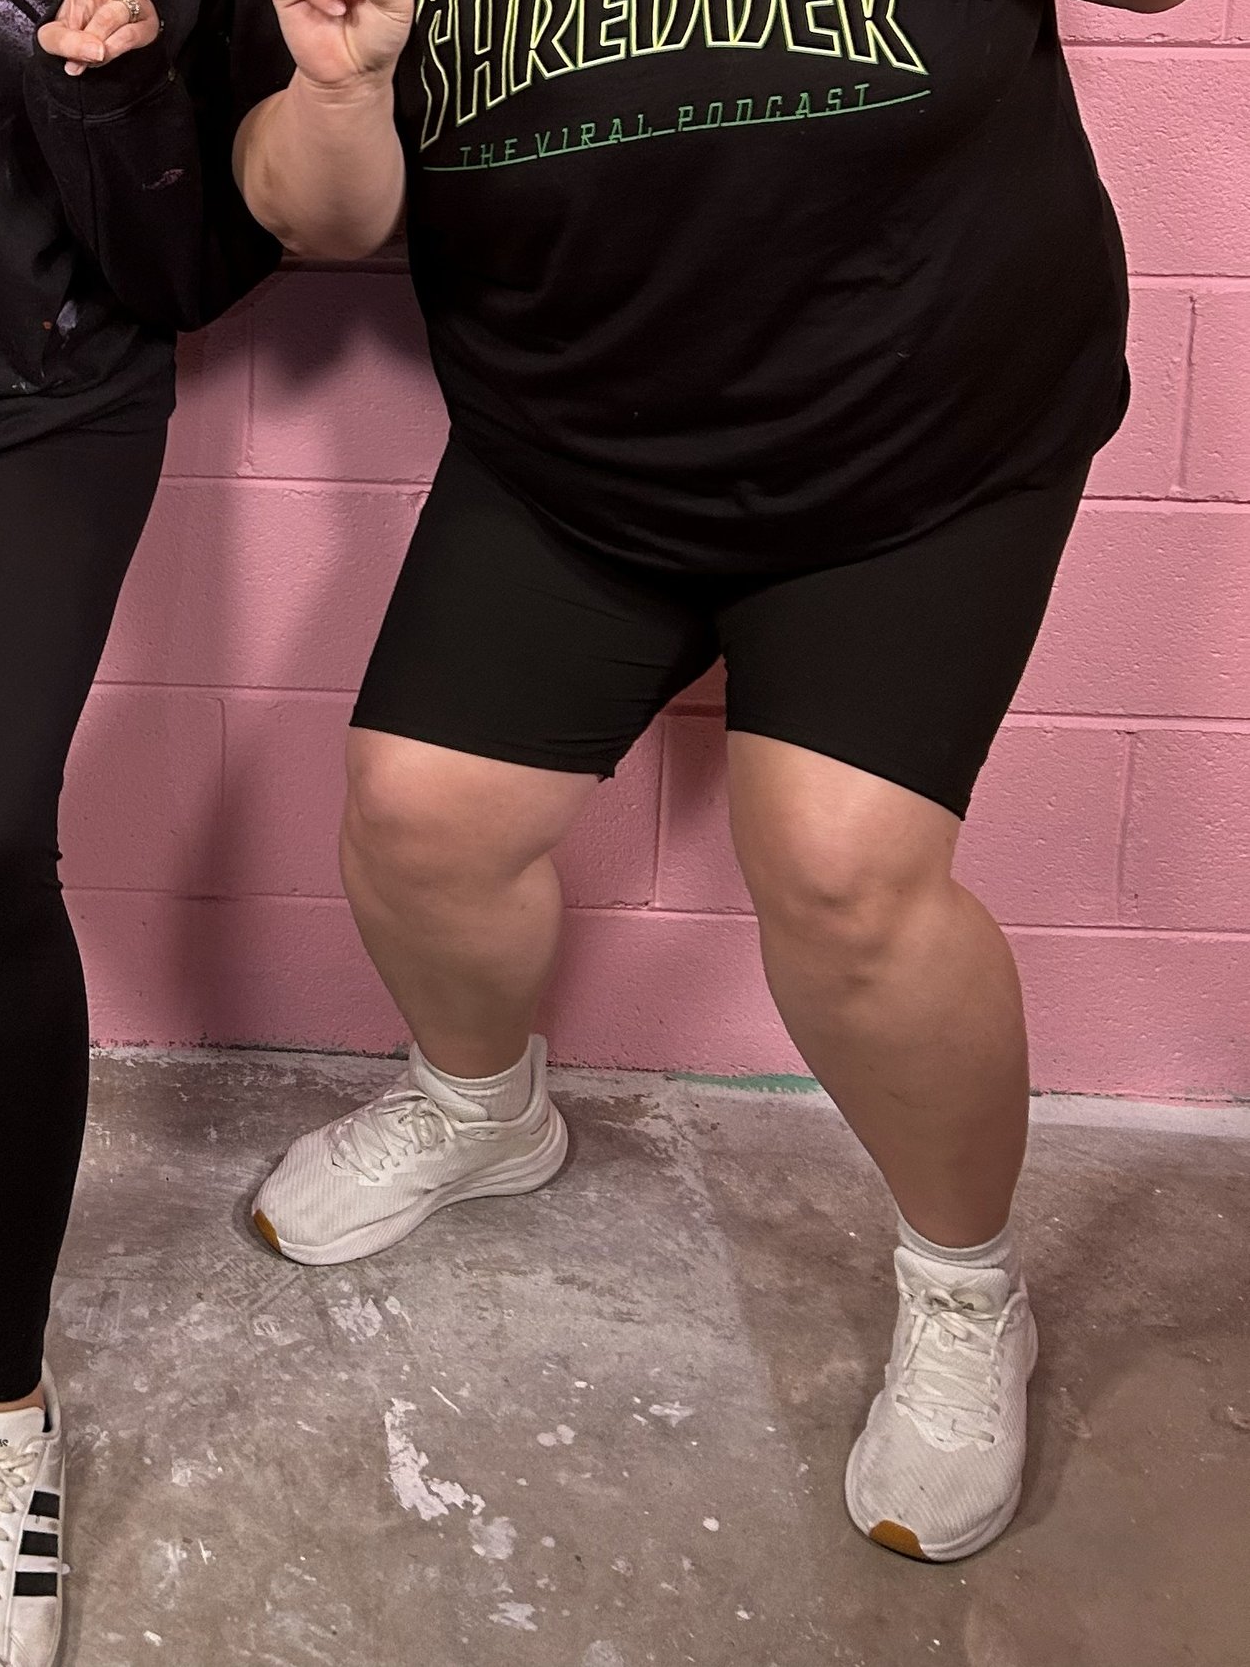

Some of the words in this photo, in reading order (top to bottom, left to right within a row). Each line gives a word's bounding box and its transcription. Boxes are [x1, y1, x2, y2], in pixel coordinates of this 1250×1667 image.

[458, 137, 518, 168] THE
[534, 113, 653, 159] VIRAL
[677, 83, 871, 132] PODCAST
